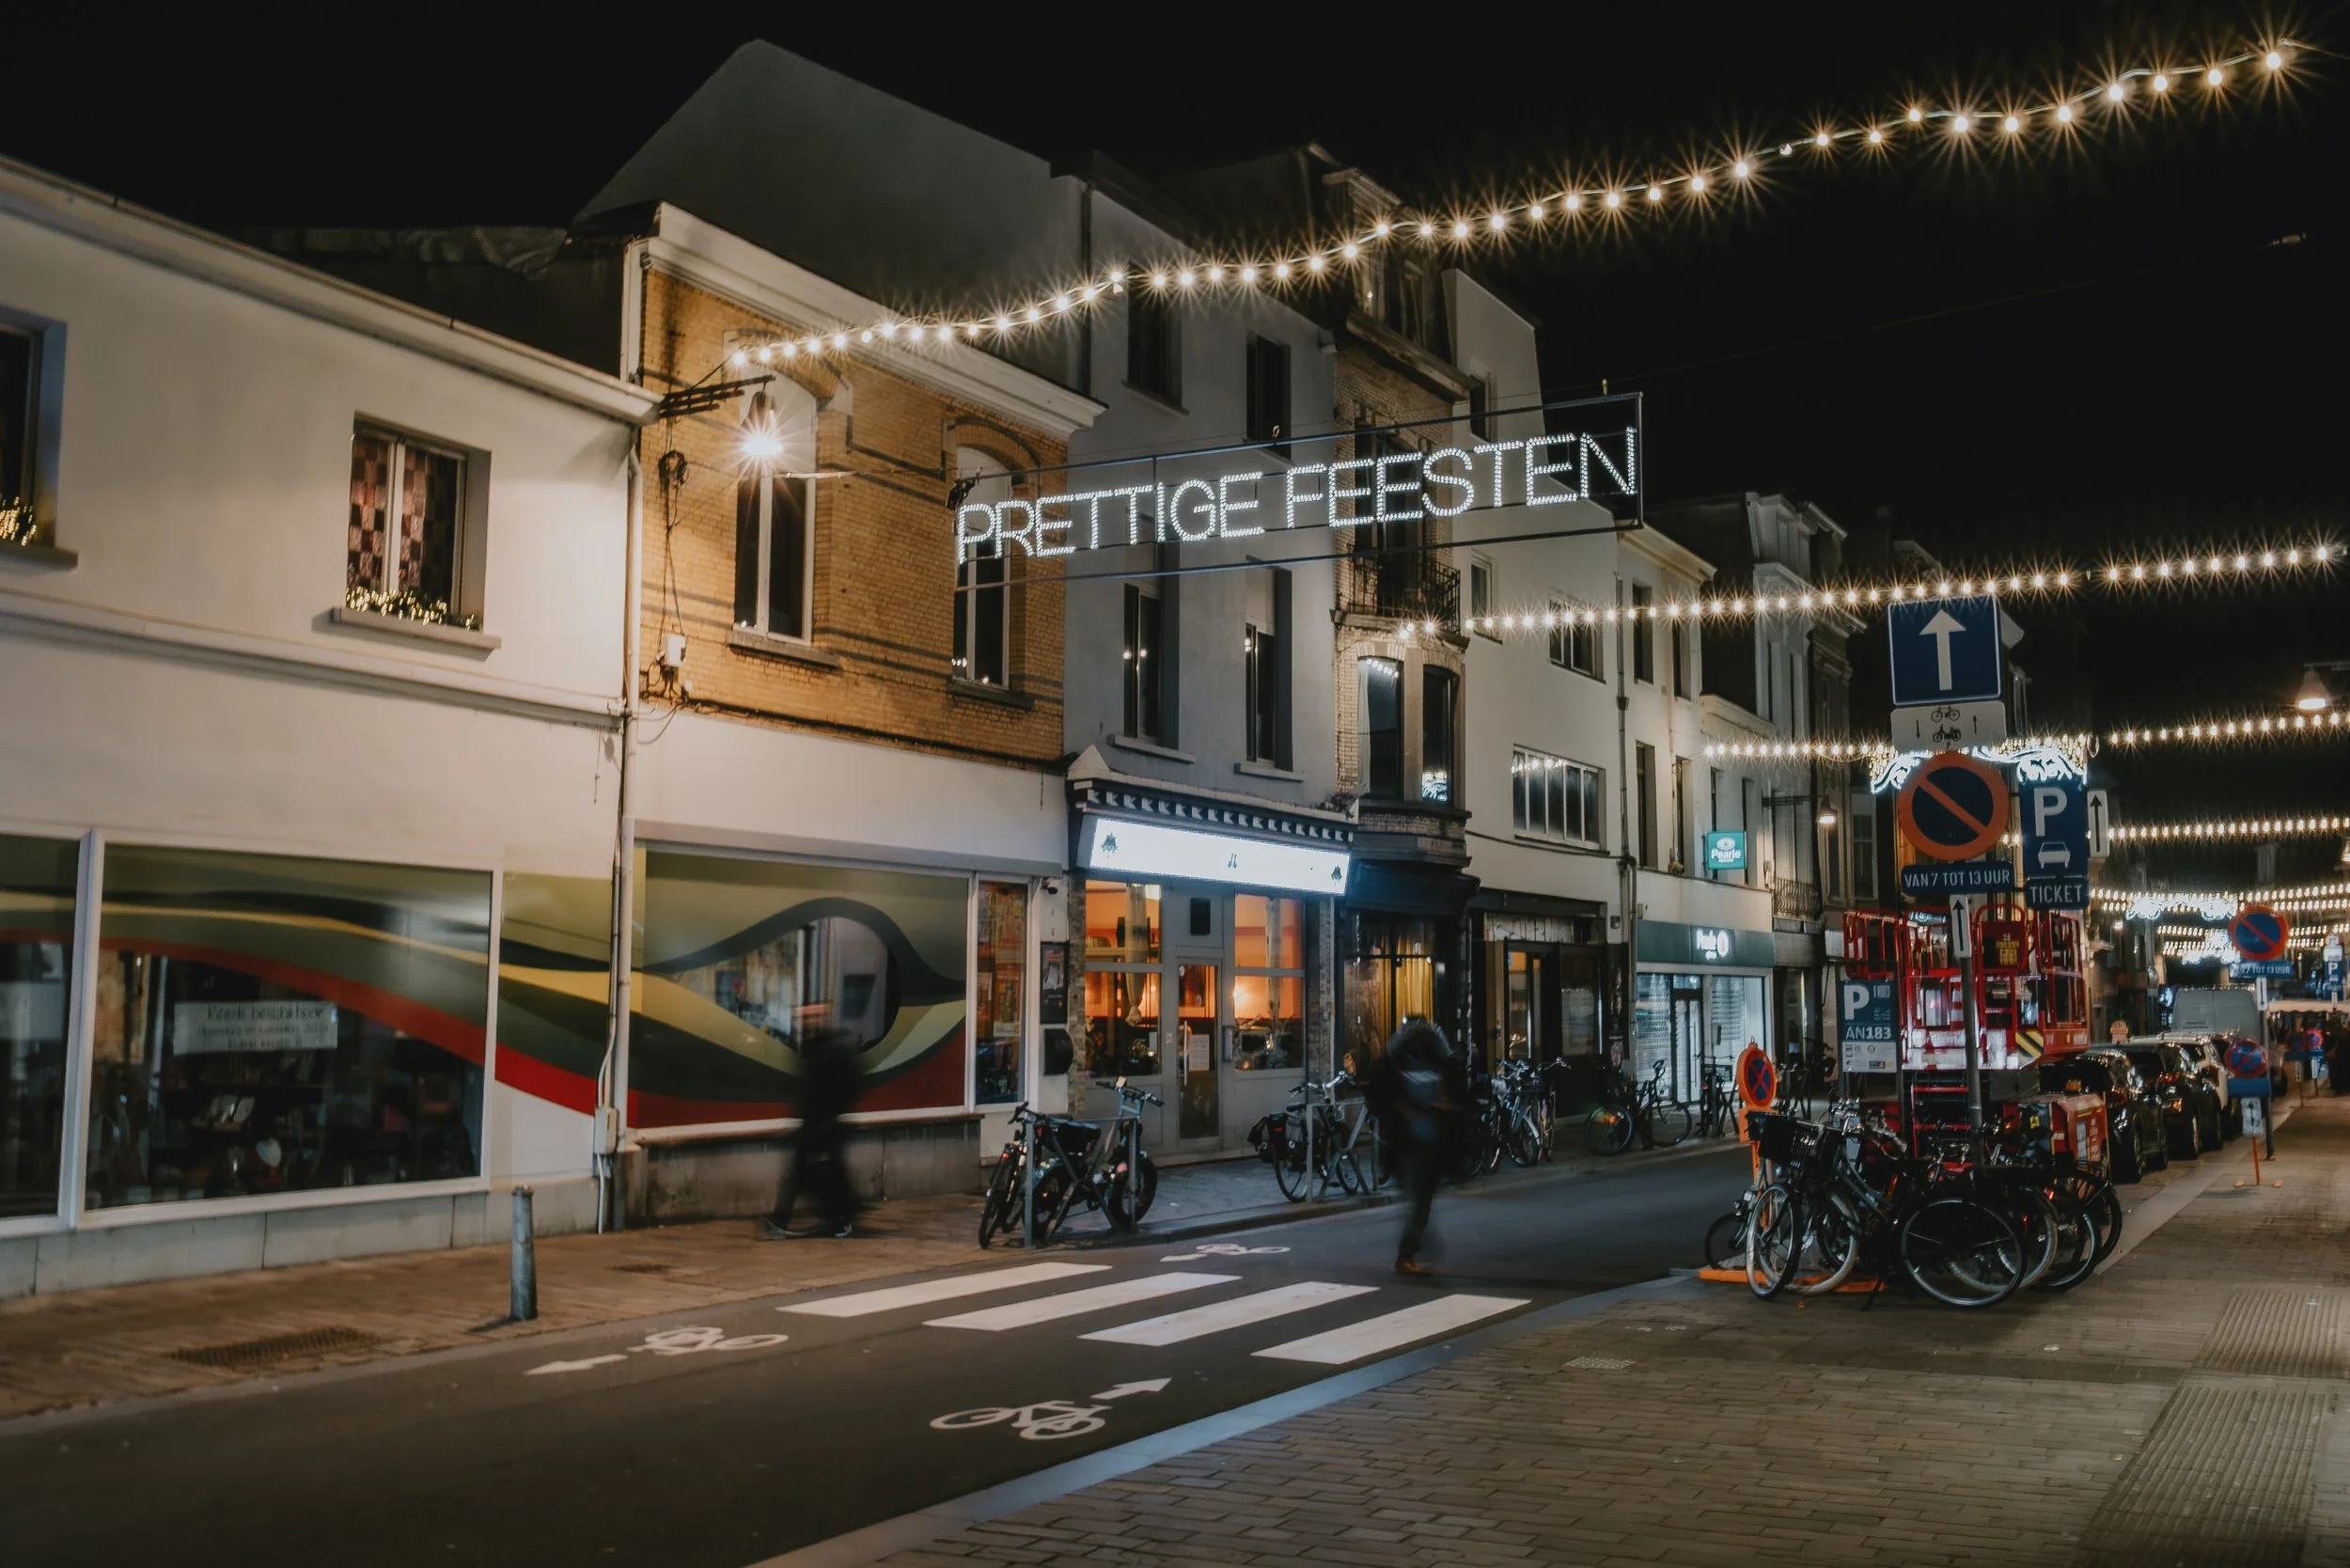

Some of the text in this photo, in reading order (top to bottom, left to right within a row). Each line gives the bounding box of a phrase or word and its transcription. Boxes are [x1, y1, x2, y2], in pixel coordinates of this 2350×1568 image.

[956, 426, 1637, 564] PRETTIGE FEESTEN
[2033, 787, 2067, 837] P
[1711, 848, 1742, 859] Pearle
[1904, 869, 2011, 888] VAN 7 TOT 13 UUR
[2029, 884, 2083, 904] TICKET
[2328, 962, 2339, 975] P
[1843, 985, 1870, 1021] P
[1845, 1025, 1892, 1041] AN183
